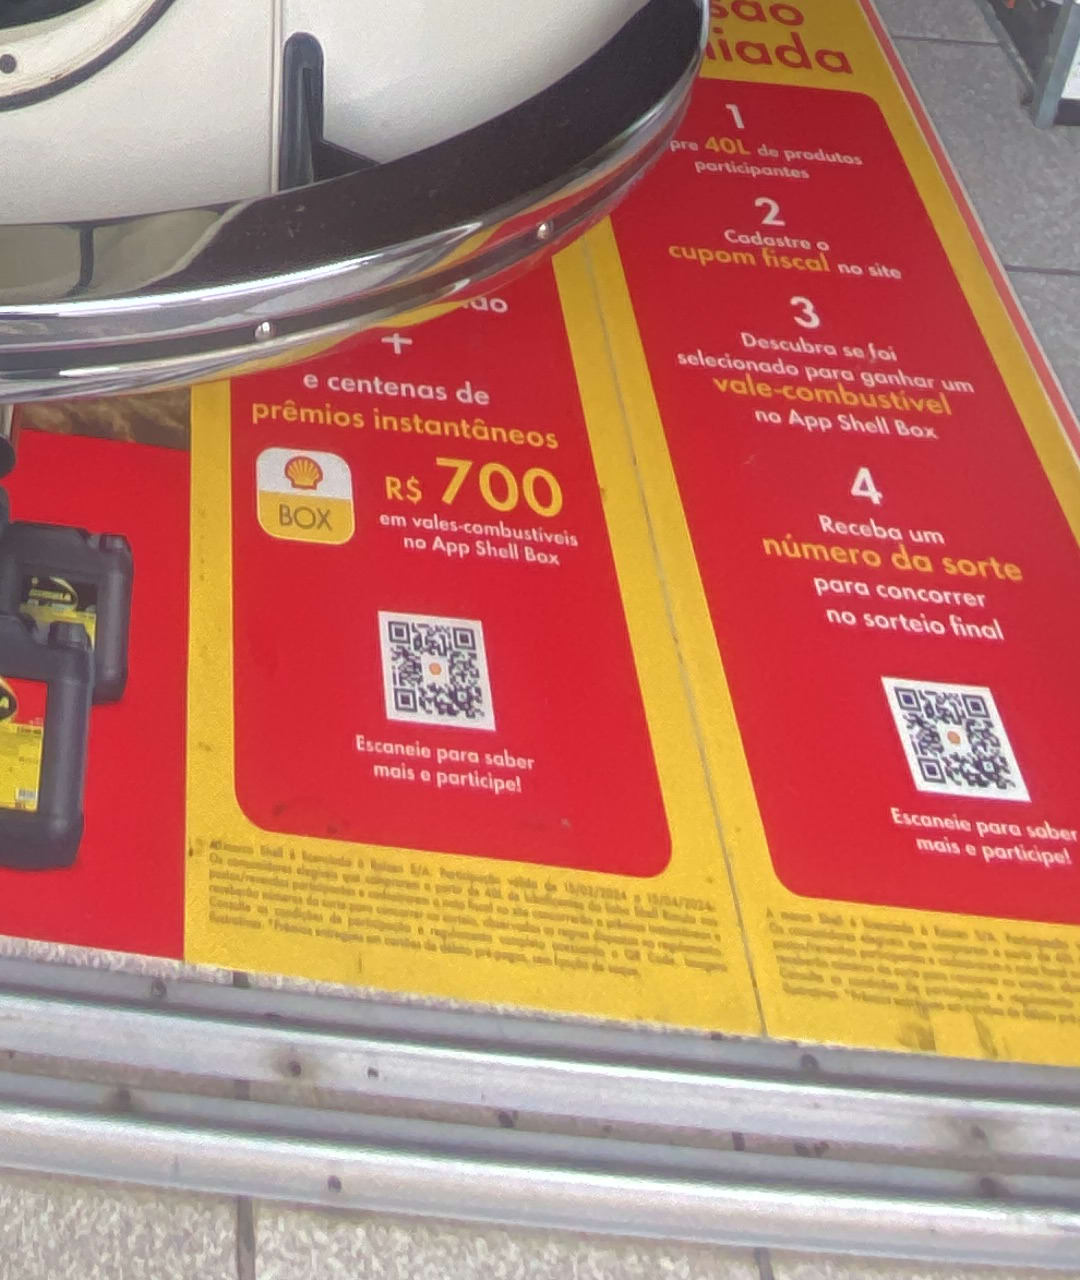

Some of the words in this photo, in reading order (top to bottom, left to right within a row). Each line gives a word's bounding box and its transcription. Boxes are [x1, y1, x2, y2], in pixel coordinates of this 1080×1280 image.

[704, 27, 853, 74] iada
[726, 104, 745, 129] 1
[669, 139, 698, 154] pre
[705, 136, 750, 156] 40L
[757, 144, 780, 159] de
[785, 147, 863, 166] produtos
[695, 158, 810, 180] participantes
[754, 197, 786, 227] 2
[724, 229, 812, 251] Cadastre
[816, 239, 830, 252] o
[668, 242, 757, 270] cupom
[762, 246, 830, 274] fiscal
[838, 262, 864, 277] no
[868, 262, 902, 281] site
[789, 296, 821, 329] 3
[741, 331, 837, 356] Descubra
[842, 345, 865, 359] se
[868, 342, 898, 363] foi
[677, 350, 800, 378] selecionado
[805, 364, 855, 386] para
[860, 370, 935, 394] ganhar
[942, 379, 974, 394] um
[303, 372, 319, 389] e
[327, 373, 447, 401] centenas
[455, 381, 490, 406] de
[713, 374, 953, 416] vale-combustível
[251, 399, 364, 429] prêmios
[373, 407, 559, 450] instantâneos
[755, 409, 782, 425] no
[788, 408, 832, 433] App
[837, 413, 890, 436] Shell
[896, 419, 939, 440] Box
[385, 474, 422, 505] R$
[435, 456, 564, 518] 700
[851, 467, 883, 505] 4
[279, 503, 333, 532] BOX
[379, 515, 407, 528] em
[411, 514, 578, 547] vales-combustíveis
[819, 514, 902, 541] Receba
[909, 528, 944, 544] um
[403, 535, 426, 549] no
[432, 535, 469, 560] App
[475, 539, 519, 561] Shell
[524, 545, 560, 565] Box
[762, 533, 882, 569] número
[891, 543, 933, 574] da
[943, 552, 1023, 582] sorte
[814, 575, 870, 597] para
[876, 582, 987, 608] concorrer
[826, 608, 856, 626] no
[863, 610, 946, 636] sorteio
[950, 615, 1005, 641] final
[355, 734, 431, 760] Escaneie
[436, 744, 479, 766] para
[484, 747, 534, 771] saber
[373, 761, 415, 781] mais
[420, 769, 431, 782] e
[436, 768, 521, 794] participe!
[890, 807, 971, 832] Escaneie
[976, 817, 1021, 838] para
[1026, 819, 1078, 842] saber
[916, 834, 961, 856] mais
[965, 843, 976, 855] e
[982, 841, 1072, 868] participe!
